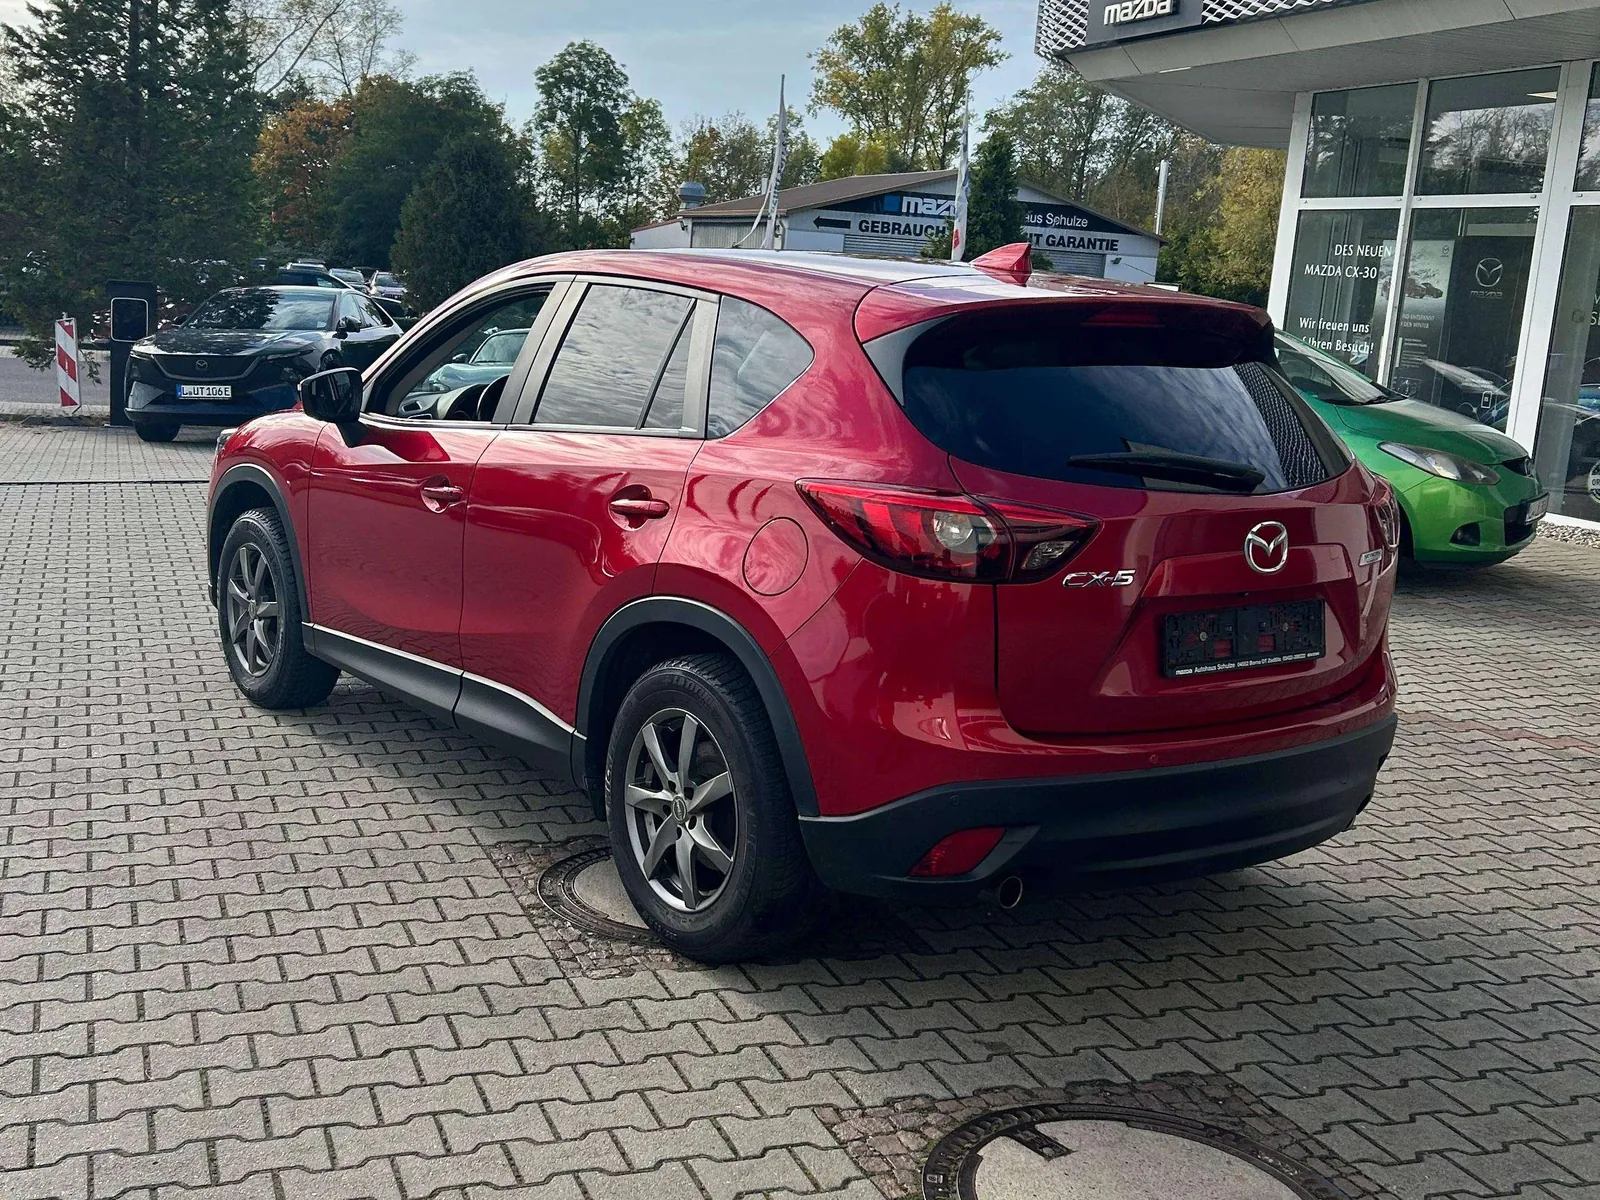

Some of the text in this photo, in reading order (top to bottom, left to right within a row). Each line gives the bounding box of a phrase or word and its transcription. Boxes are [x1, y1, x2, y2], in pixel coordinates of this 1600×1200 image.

[1103, 0, 1173, 25] mazda
[902, 196, 955, 216] maz
[1045, 212, 1088, 227] Schulze
[858, 219, 946, 238] GEBRAUCH
[1045, 234, 1119, 251] GARANTIE
[1334, 244, 1393, 257] DES NEUEN
[1304, 264, 1377, 279] MAZDA CX-30
[1299, 317, 1370, 333] Wir freuen uns
[1335, 340, 1374, 354] Besuch!
[1062, 569, 1136, 588] CX-5
